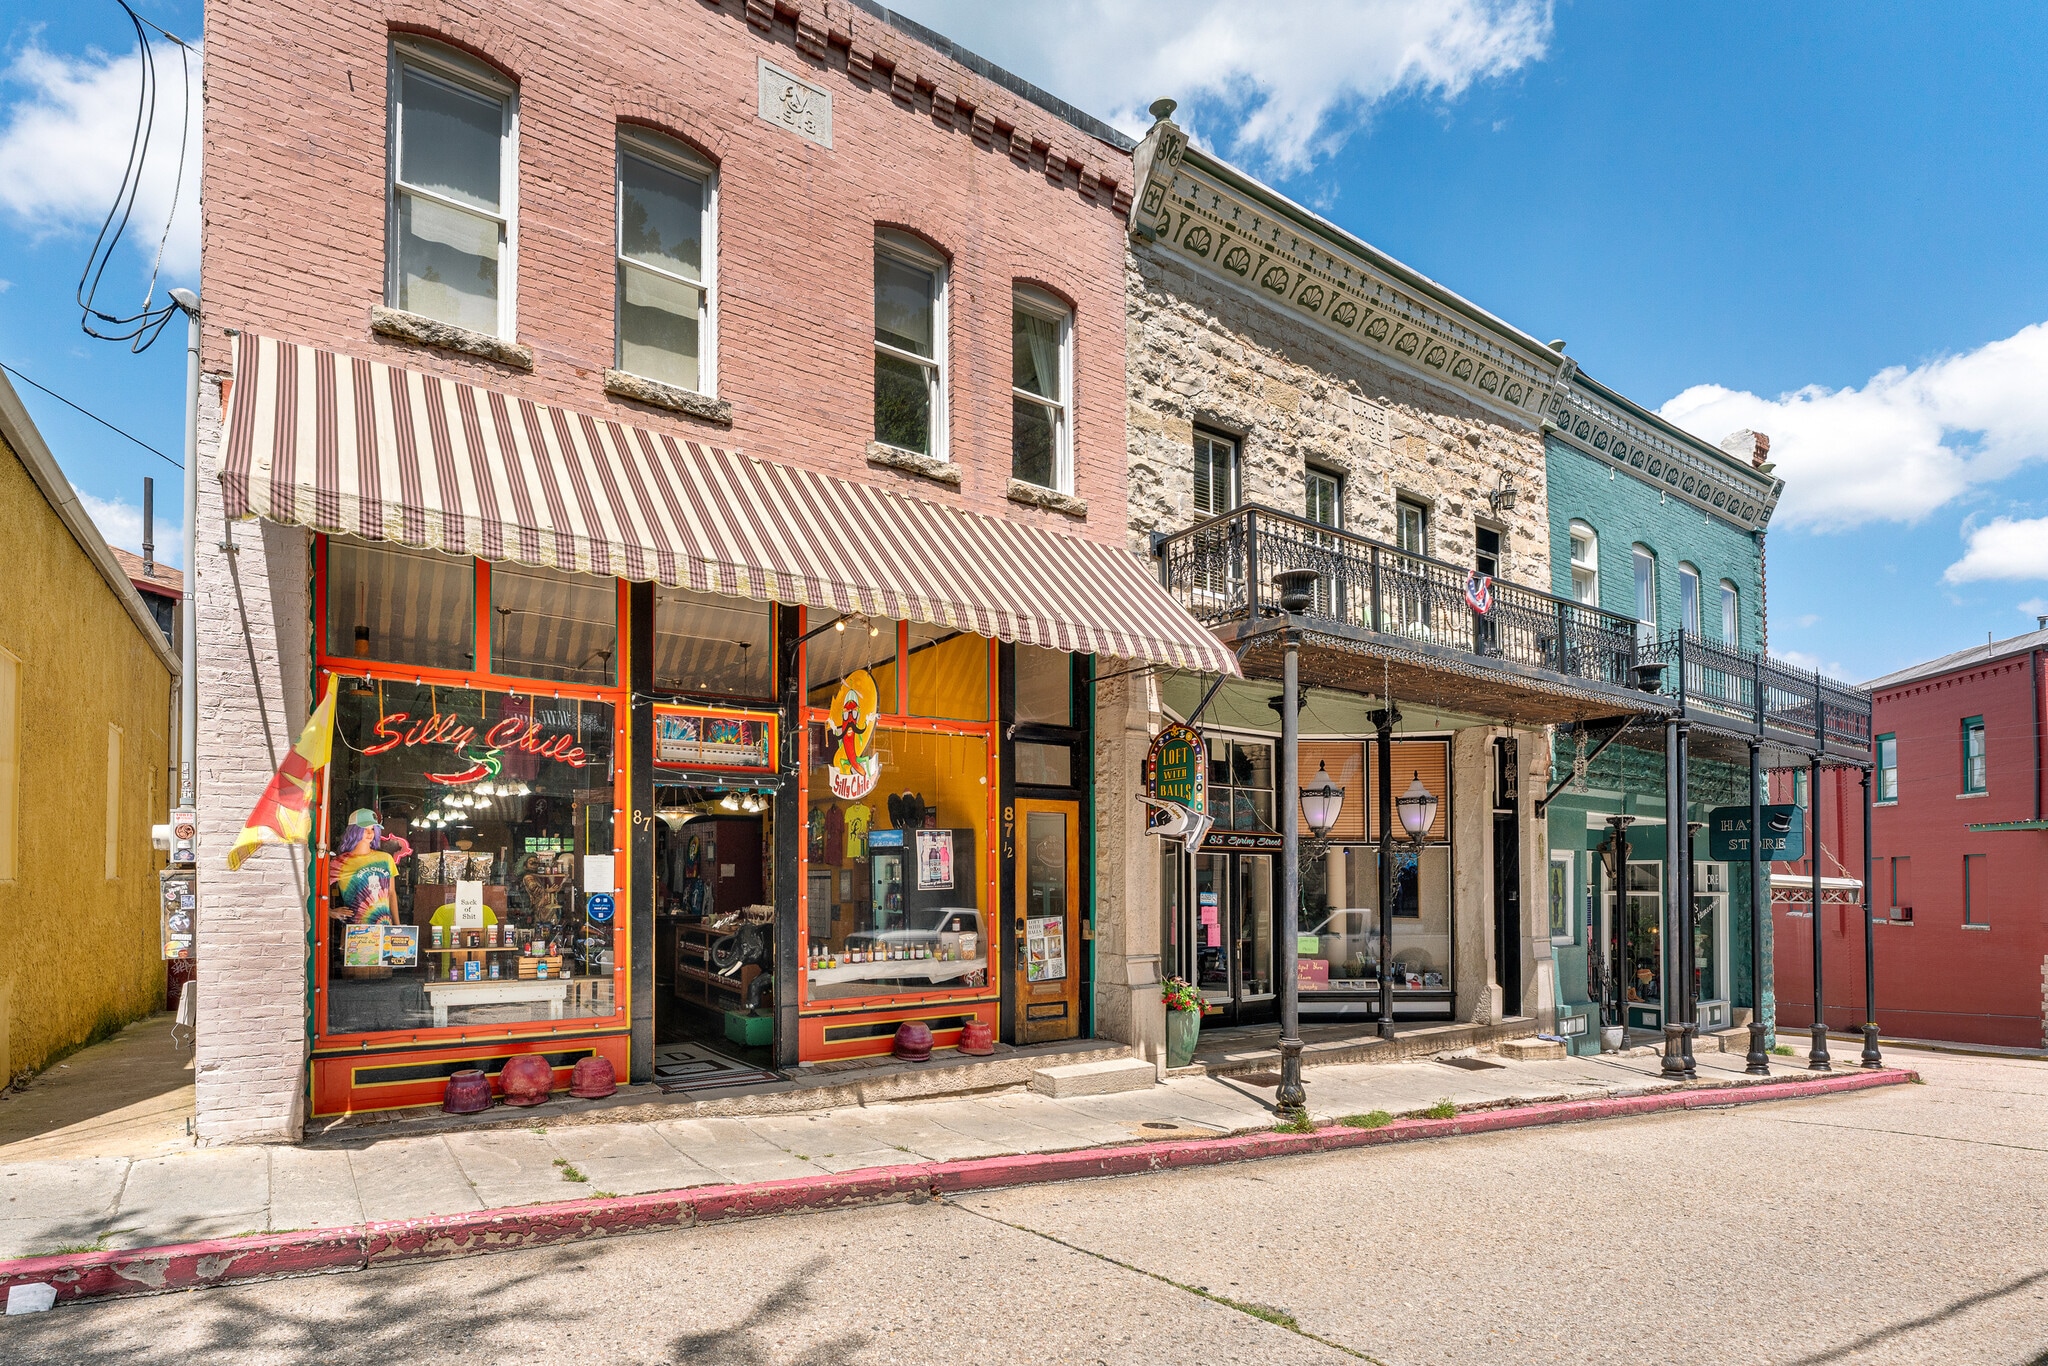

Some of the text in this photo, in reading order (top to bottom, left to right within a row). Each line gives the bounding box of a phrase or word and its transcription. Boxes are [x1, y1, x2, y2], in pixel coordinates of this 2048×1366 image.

[362, 711, 587, 768] Silly Chile
[1162, 746, 1188, 766] LOFT
[1163, 768, 1187, 780] WITH
[833, 774, 870, 798] Silly Chile
[1160, 783, 1192, 801] BALLS
[633, 809, 652, 832] 87
[1209, 834, 1283, 848] 85 Spring Street
[1728, 837, 1786, 851] STRE
